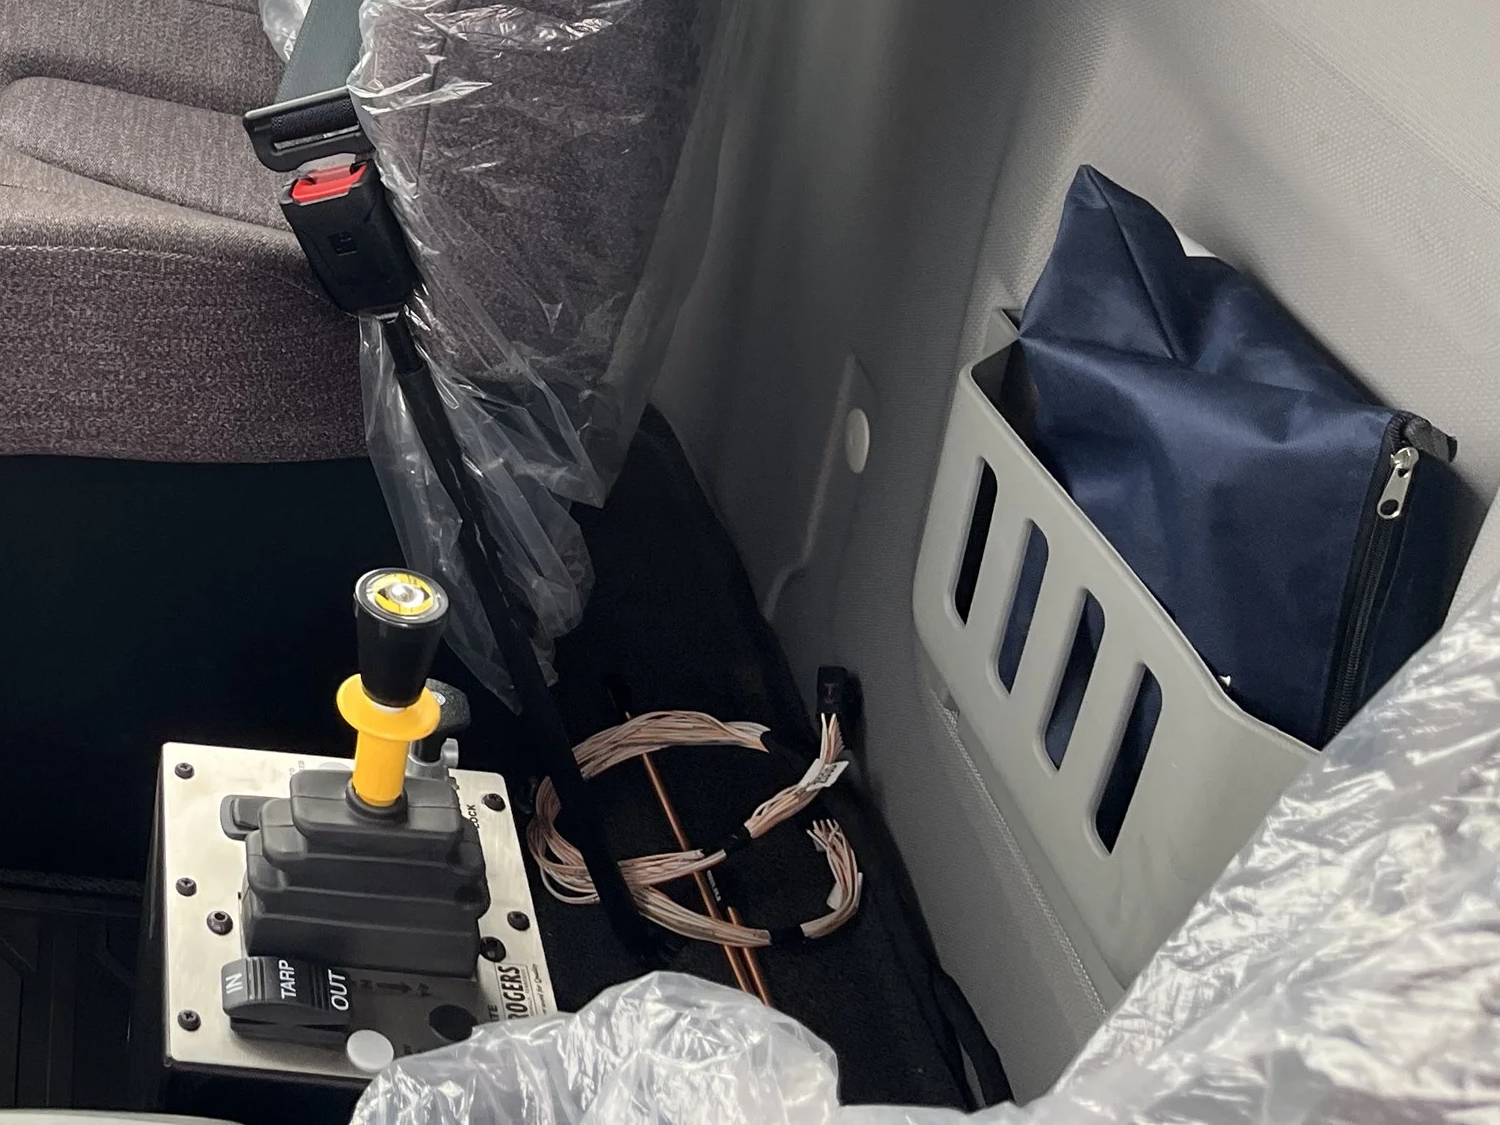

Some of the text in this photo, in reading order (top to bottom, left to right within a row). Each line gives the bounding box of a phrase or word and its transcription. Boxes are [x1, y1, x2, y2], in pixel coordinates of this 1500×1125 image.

[225, 972, 244, 994] IN
[278, 959, 297, 1000] TARP
[327, 968, 349, 1011] OUT
